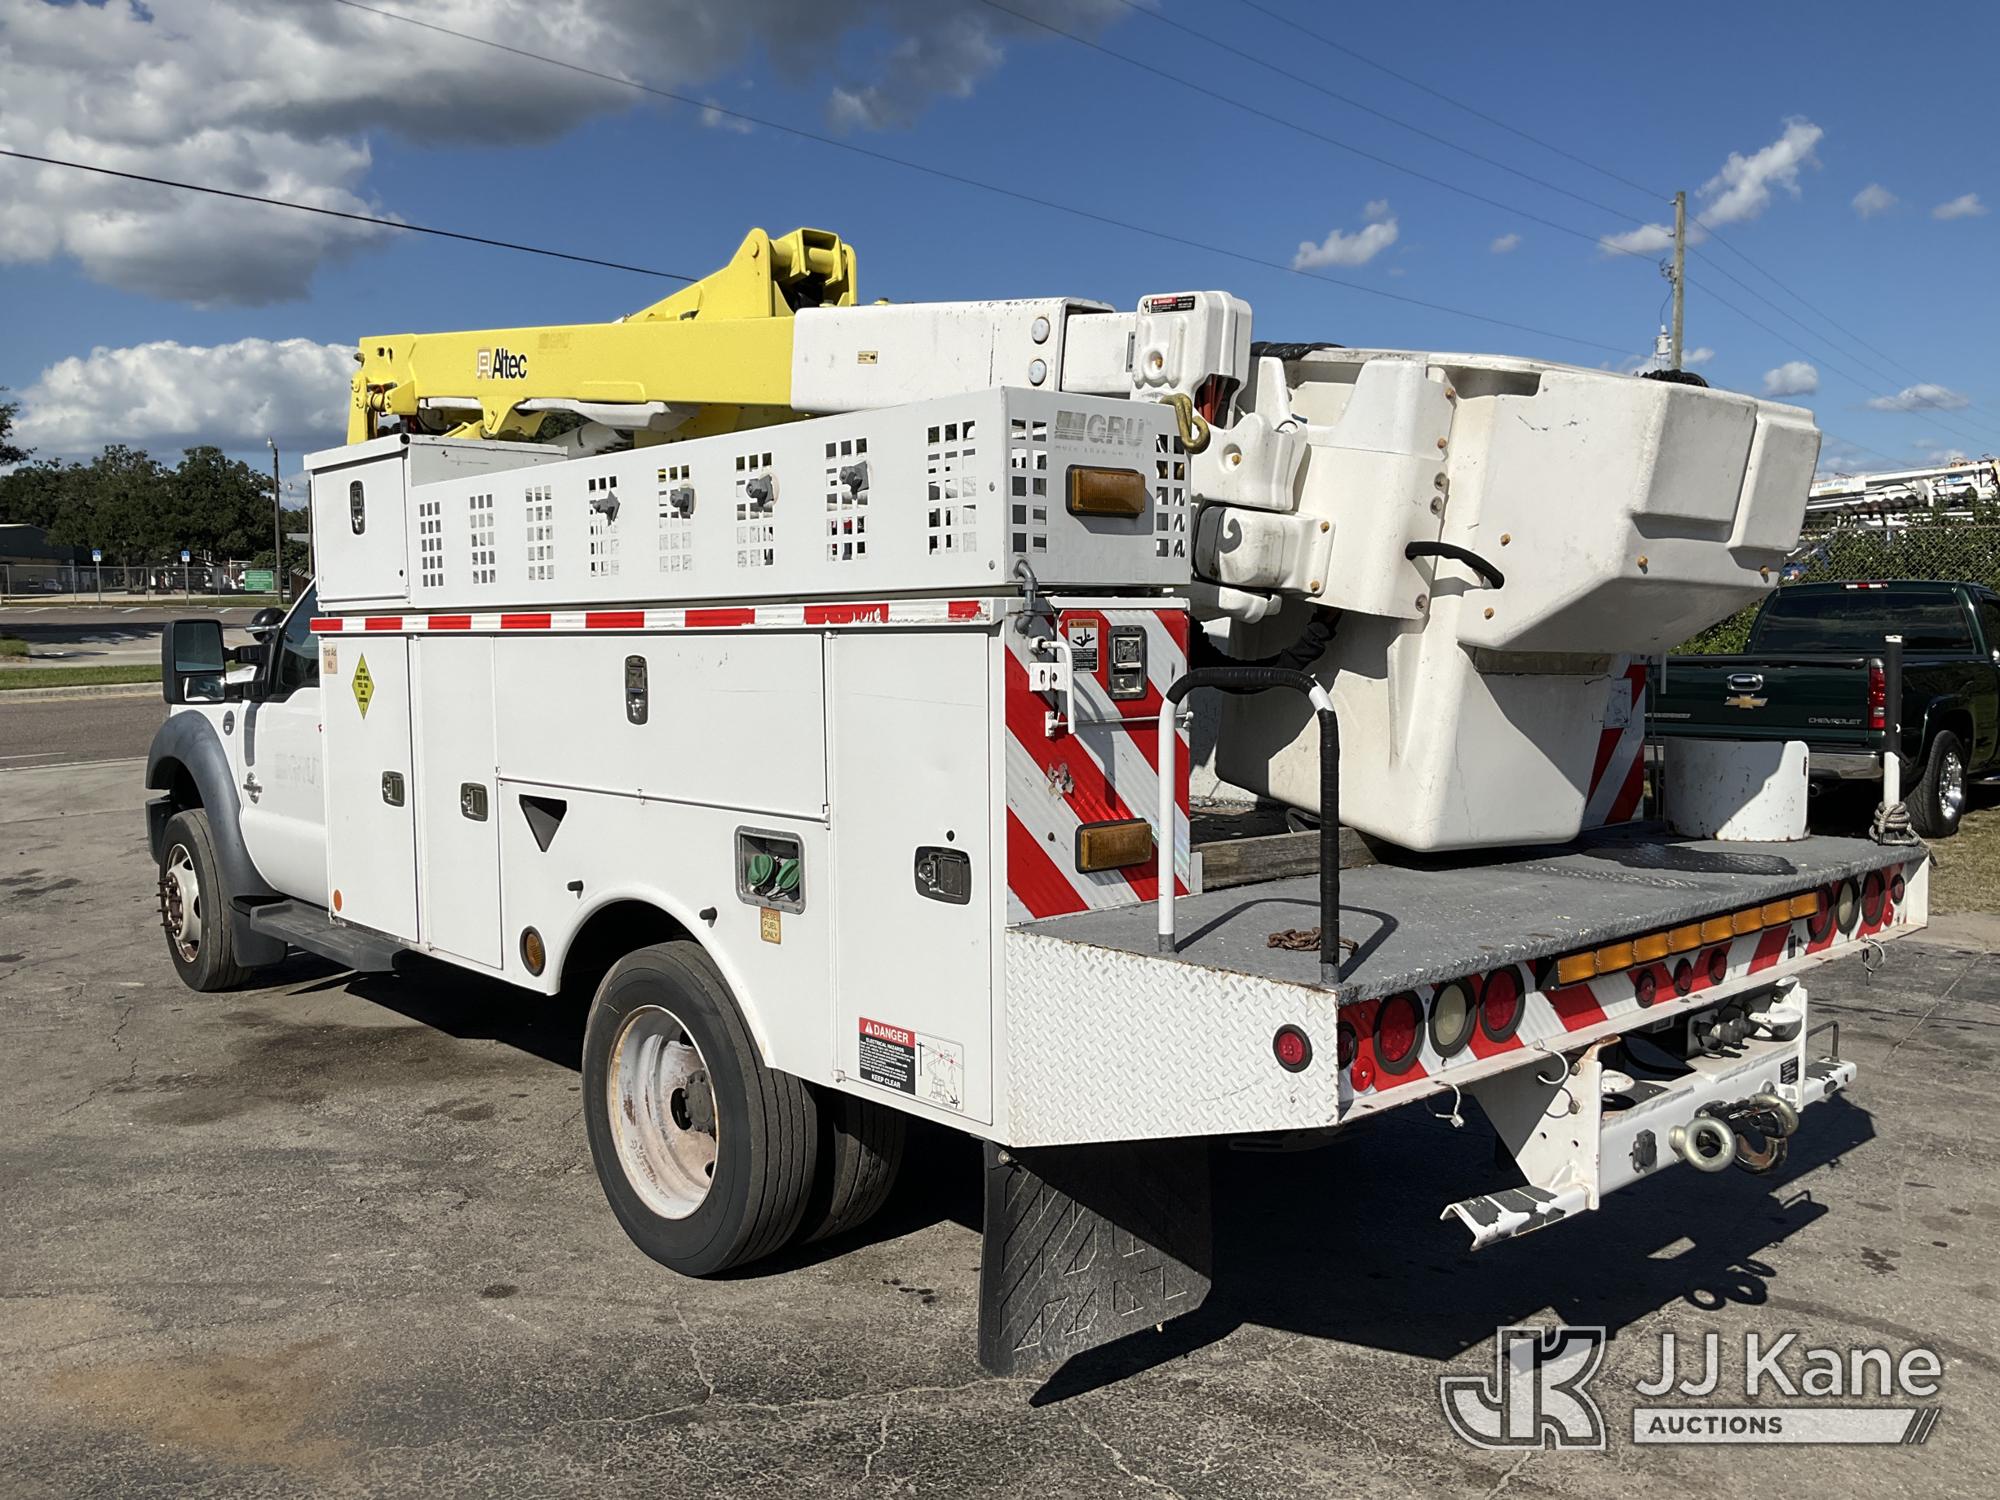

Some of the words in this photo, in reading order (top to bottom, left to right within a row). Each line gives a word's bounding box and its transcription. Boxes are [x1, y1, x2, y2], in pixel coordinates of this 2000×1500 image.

[492, 347, 527, 379] Altec
[1086, 414, 1145, 447] GRU
[1808, 717, 1862, 725] CHEVROLET
[764, 920, 777, 930] FUEL
[764, 929, 778, 939] ONLY
[873, 1024, 909, 1044] DANGER
[865, 1037, 887, 1048] ELECTRICAL
[871, 1073, 884, 1083] KEEP
[884, 1078, 901, 1089] CLEAR
